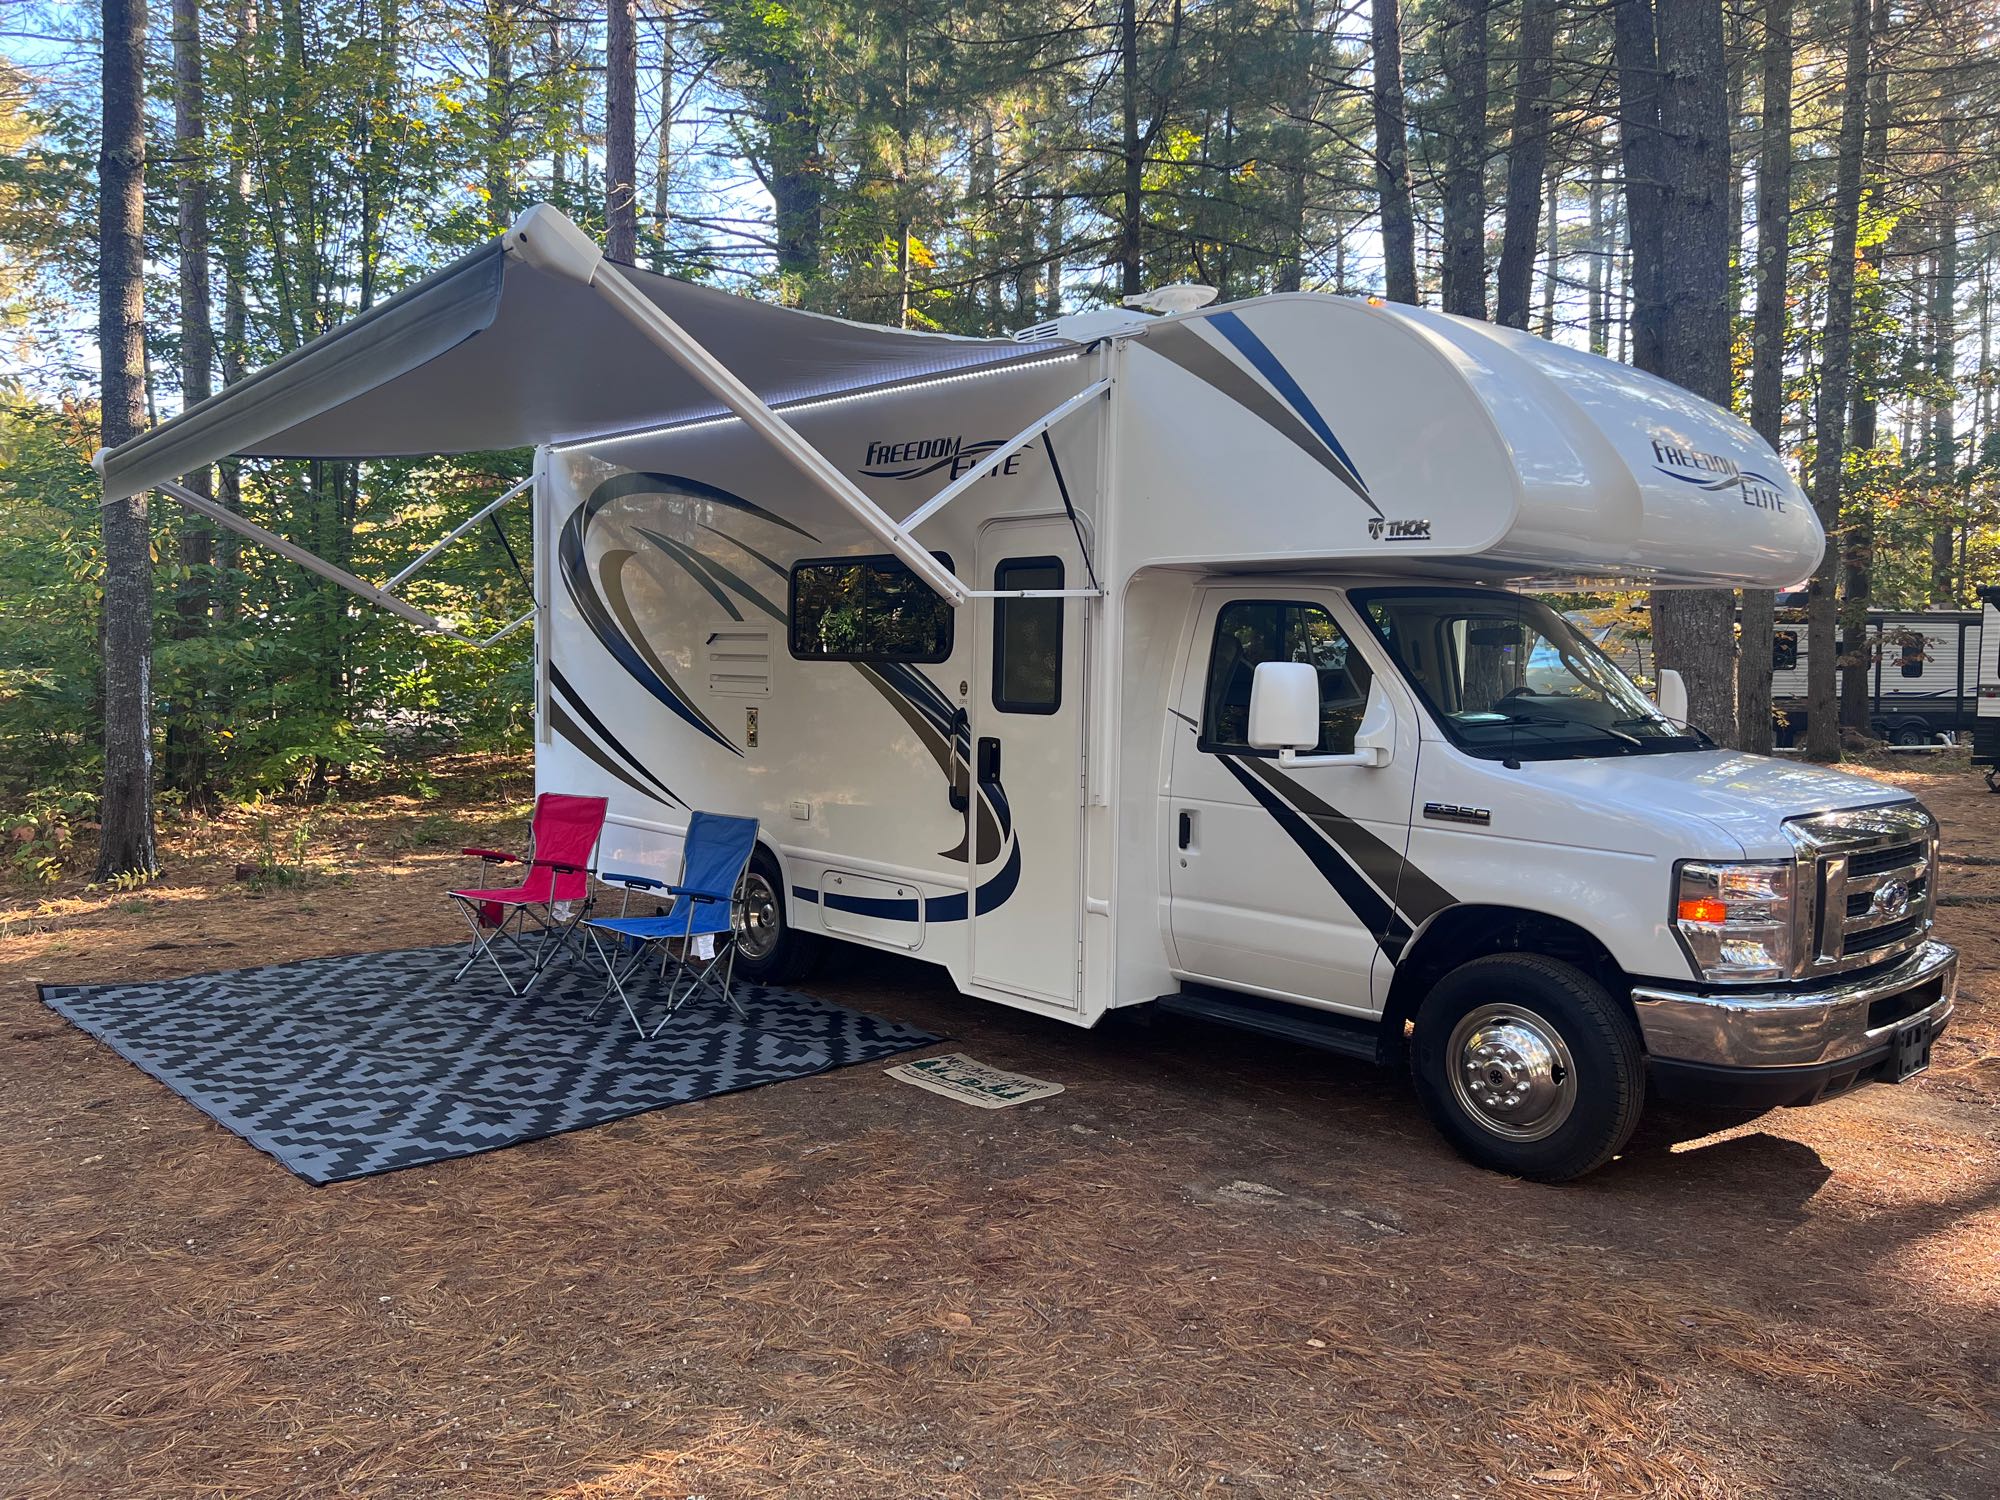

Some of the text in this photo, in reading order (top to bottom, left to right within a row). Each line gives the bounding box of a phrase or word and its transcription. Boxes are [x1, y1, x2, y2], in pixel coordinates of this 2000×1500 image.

[865, 436, 962, 466] FREEDOM
[1651, 439, 1739, 477] FREEDOM
[1740, 480, 1787, 514] ELITE
[1386, 519, 1431, 536] THOR
